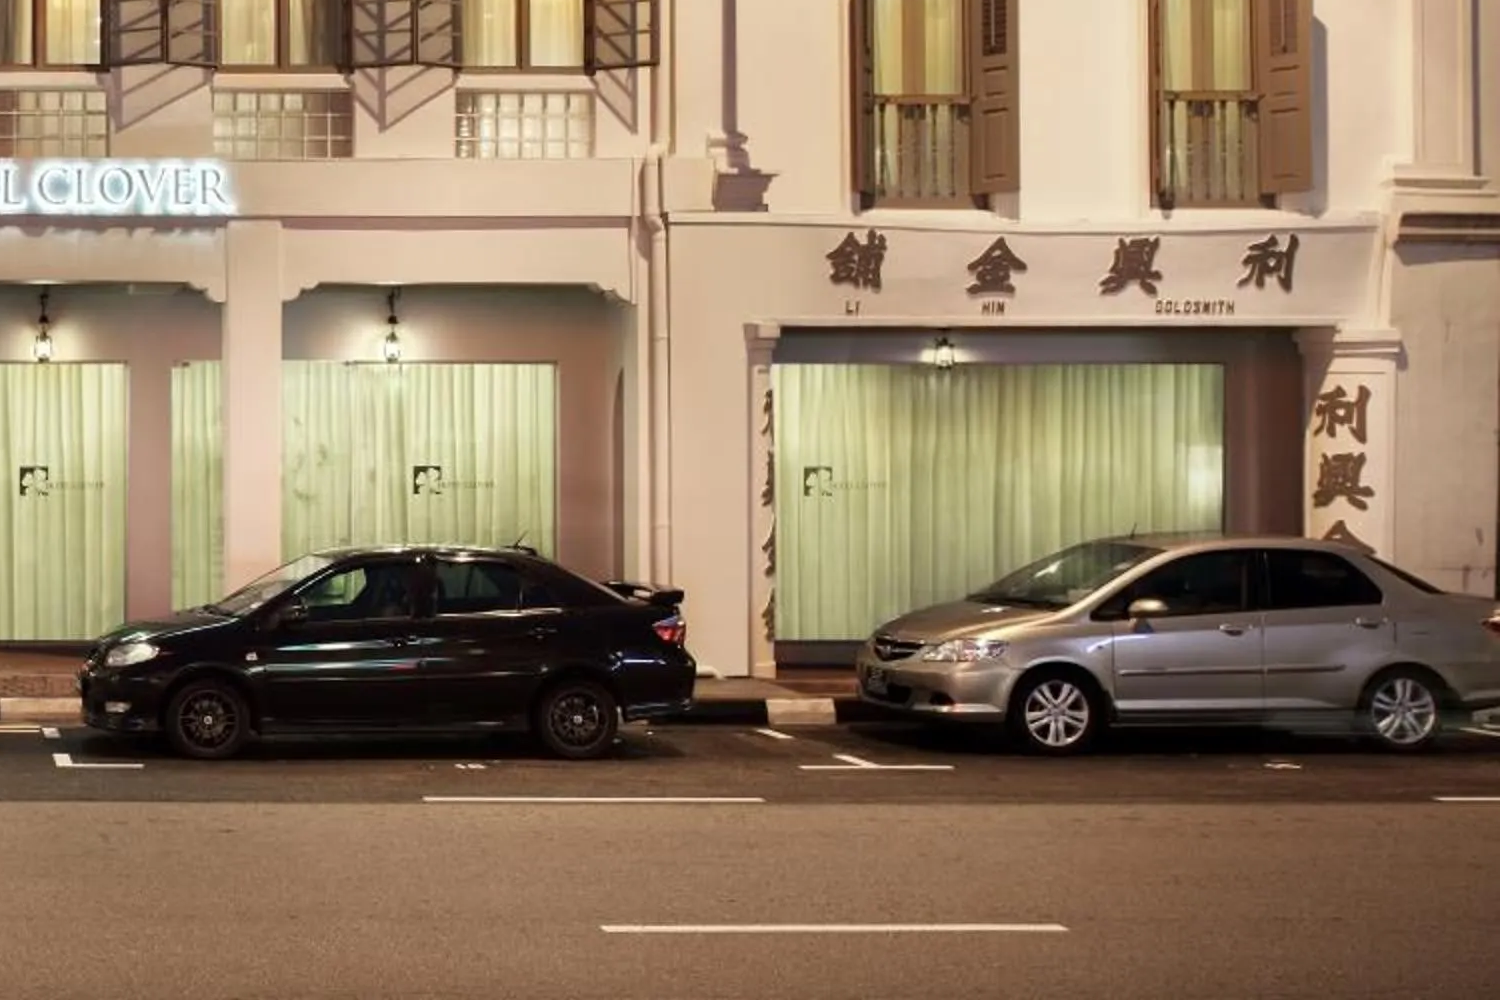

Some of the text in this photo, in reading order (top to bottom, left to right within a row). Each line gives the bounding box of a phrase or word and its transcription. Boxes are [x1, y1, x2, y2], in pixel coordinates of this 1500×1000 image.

[36, 166, 230, 206] CLOVER
[845, 300, 861, 316] LI
[1155, 299, 1235, 316] GOLDSMITH
